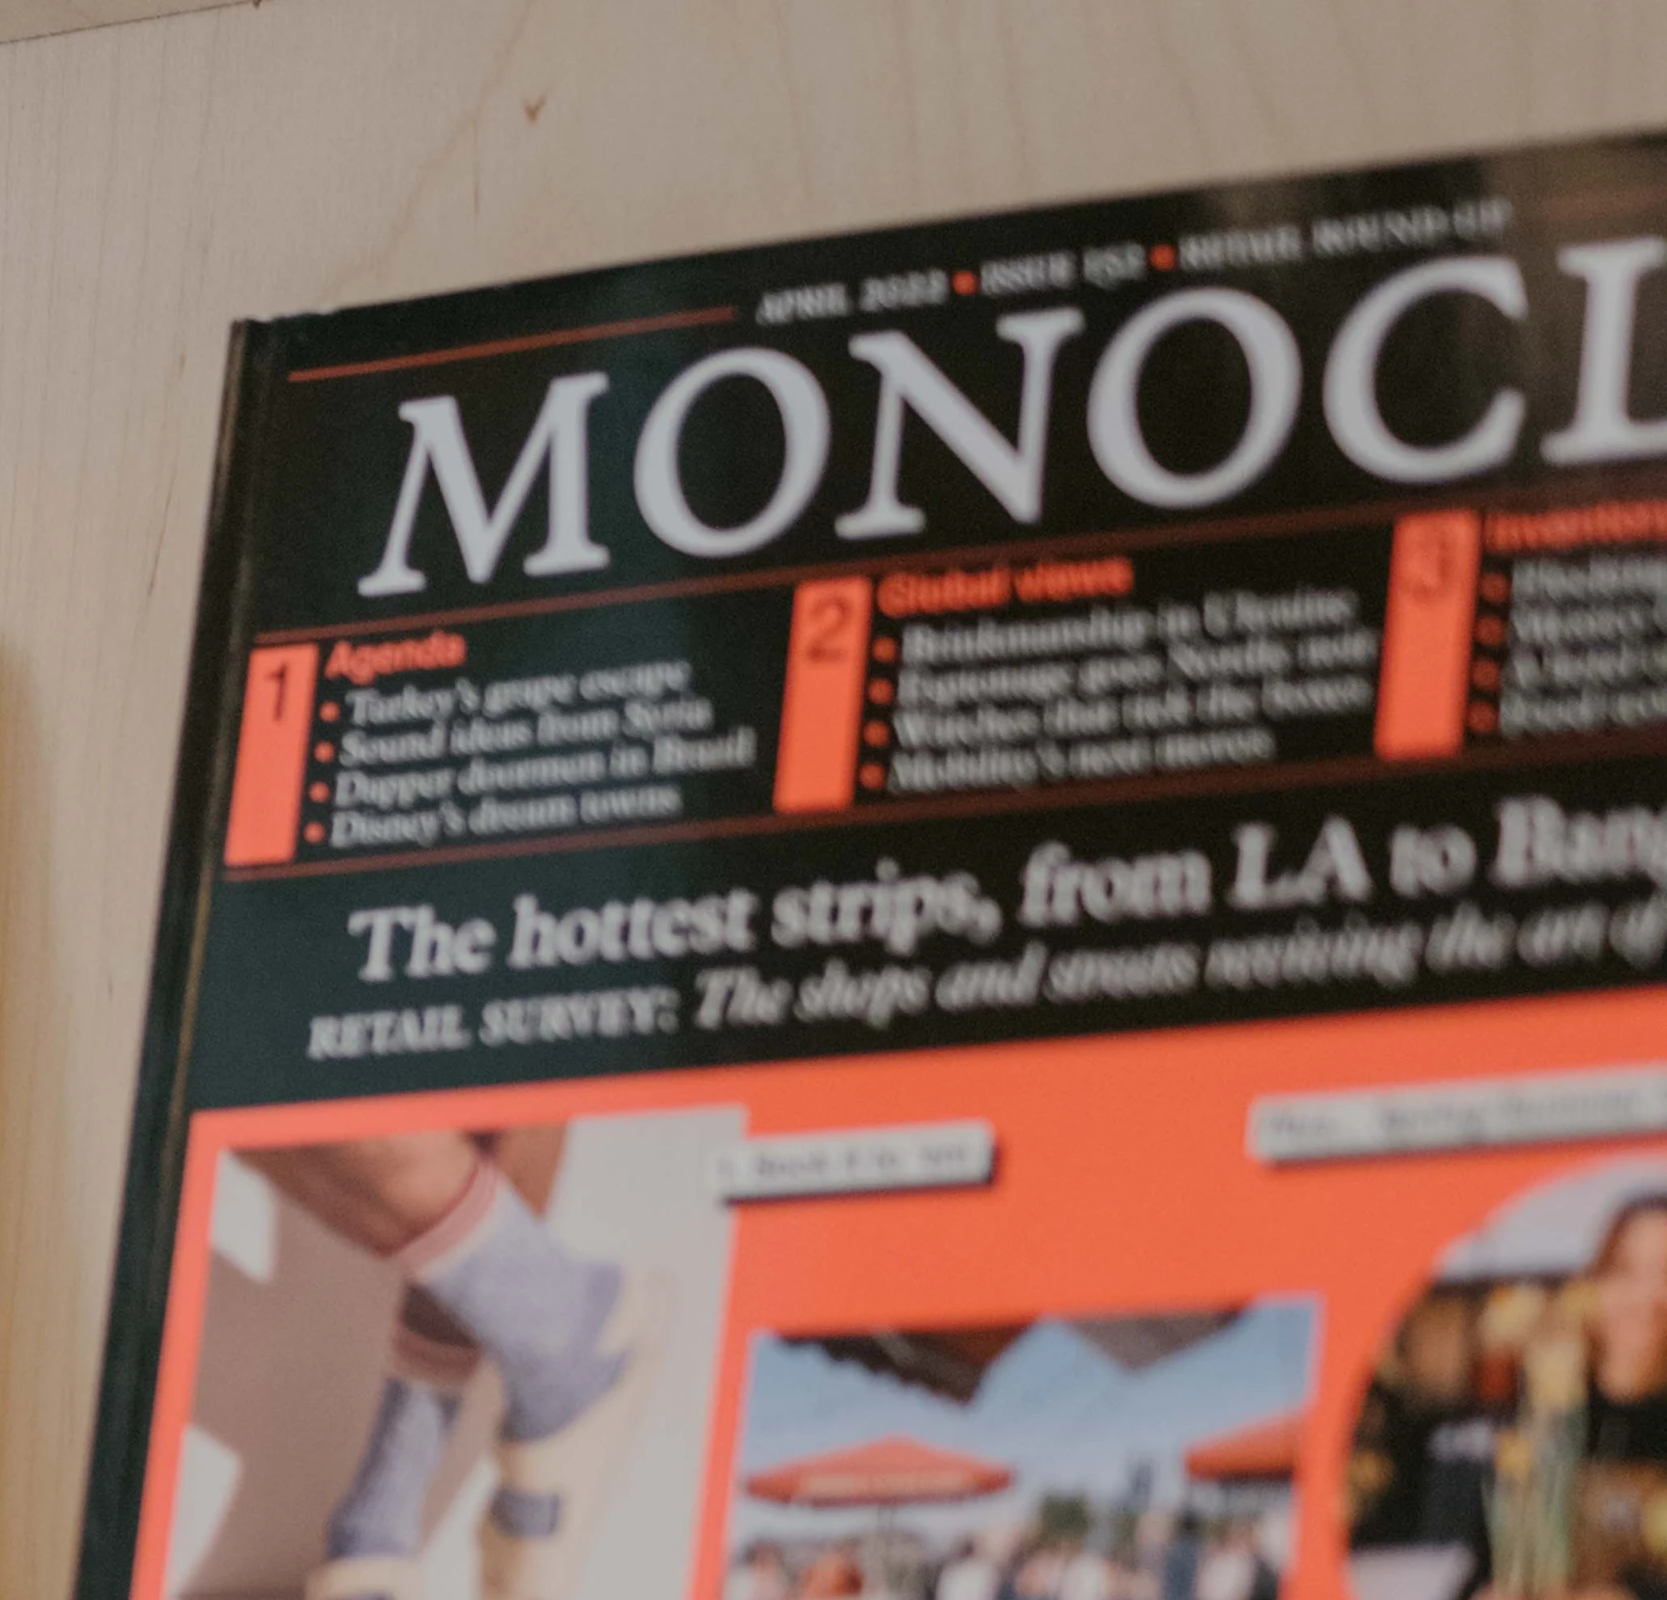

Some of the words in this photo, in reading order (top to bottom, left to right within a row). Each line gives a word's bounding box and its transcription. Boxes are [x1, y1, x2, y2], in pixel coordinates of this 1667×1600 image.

[755, 282, 848, 326] APRIL
[860, 269, 947, 313] 2022
[978, 250, 1076, 297] ISSUE
[876, 565, 1012, 618] Global
[1014, 556, 1135, 602] views
[324, 630, 466, 685] Agenda
[806, 600, 847, 664] 2
[901, 602, 1155, 666] Brinkmanship
[1157, 596, 1202, 642] in
[1203, 585, 1361, 638] Ukraine
[264, 662, 289, 722] 1
[346, 676, 481, 727] Turkey's
[482, 673, 577, 719] grape
[578, 659, 692, 707] escape
[897, 658, 1075, 710] Espionage
[1076, 653, 1165, 699] goes
[1168, 636, 1292, 683] Nordic
[338, 719, 447, 768] Sound
[450, 714, 534, 757] ideas
[535, 705, 619, 746] from
[620, 693, 714, 740] Syria
[892, 702, 1042, 749] Watches
[1043, 696, 1120, 739] that
[1121, 688, 1194, 731] tick
[1195, 681, 1260, 724] the
[334, 767, 456, 813] Dapper
[457, 747, 607, 795] doormen
[609, 739, 649, 780] in
[651, 724, 759, 775] Brazil
[1067, 734, 1155, 778] next
[1155, 725, 1277, 770] moves
[328, 800, 466, 849] Disney's
[467, 792, 578, 838] dream
[579, 783, 682, 826] towns
[348, 904, 497, 983] The
[508, 887, 759, 971] hottest
[770, 855, 1003, 958] strips,
[1017, 840, 1212, 930] from
[1230, 814, 1373, 911] LA
[1388, 822, 1478, 901] to
[306, 1004, 468, 1061] RETAIL
[479, 984, 681, 1048] SURVEY:
[693, 964, 786, 1032] The
[793, 955, 934, 1030] shops
[935, 938, 1048, 1016] and
[1044, 938, 1203, 1004] streets
[1424, 900, 1516, 972] the
[1516, 902, 1609, 968] art
